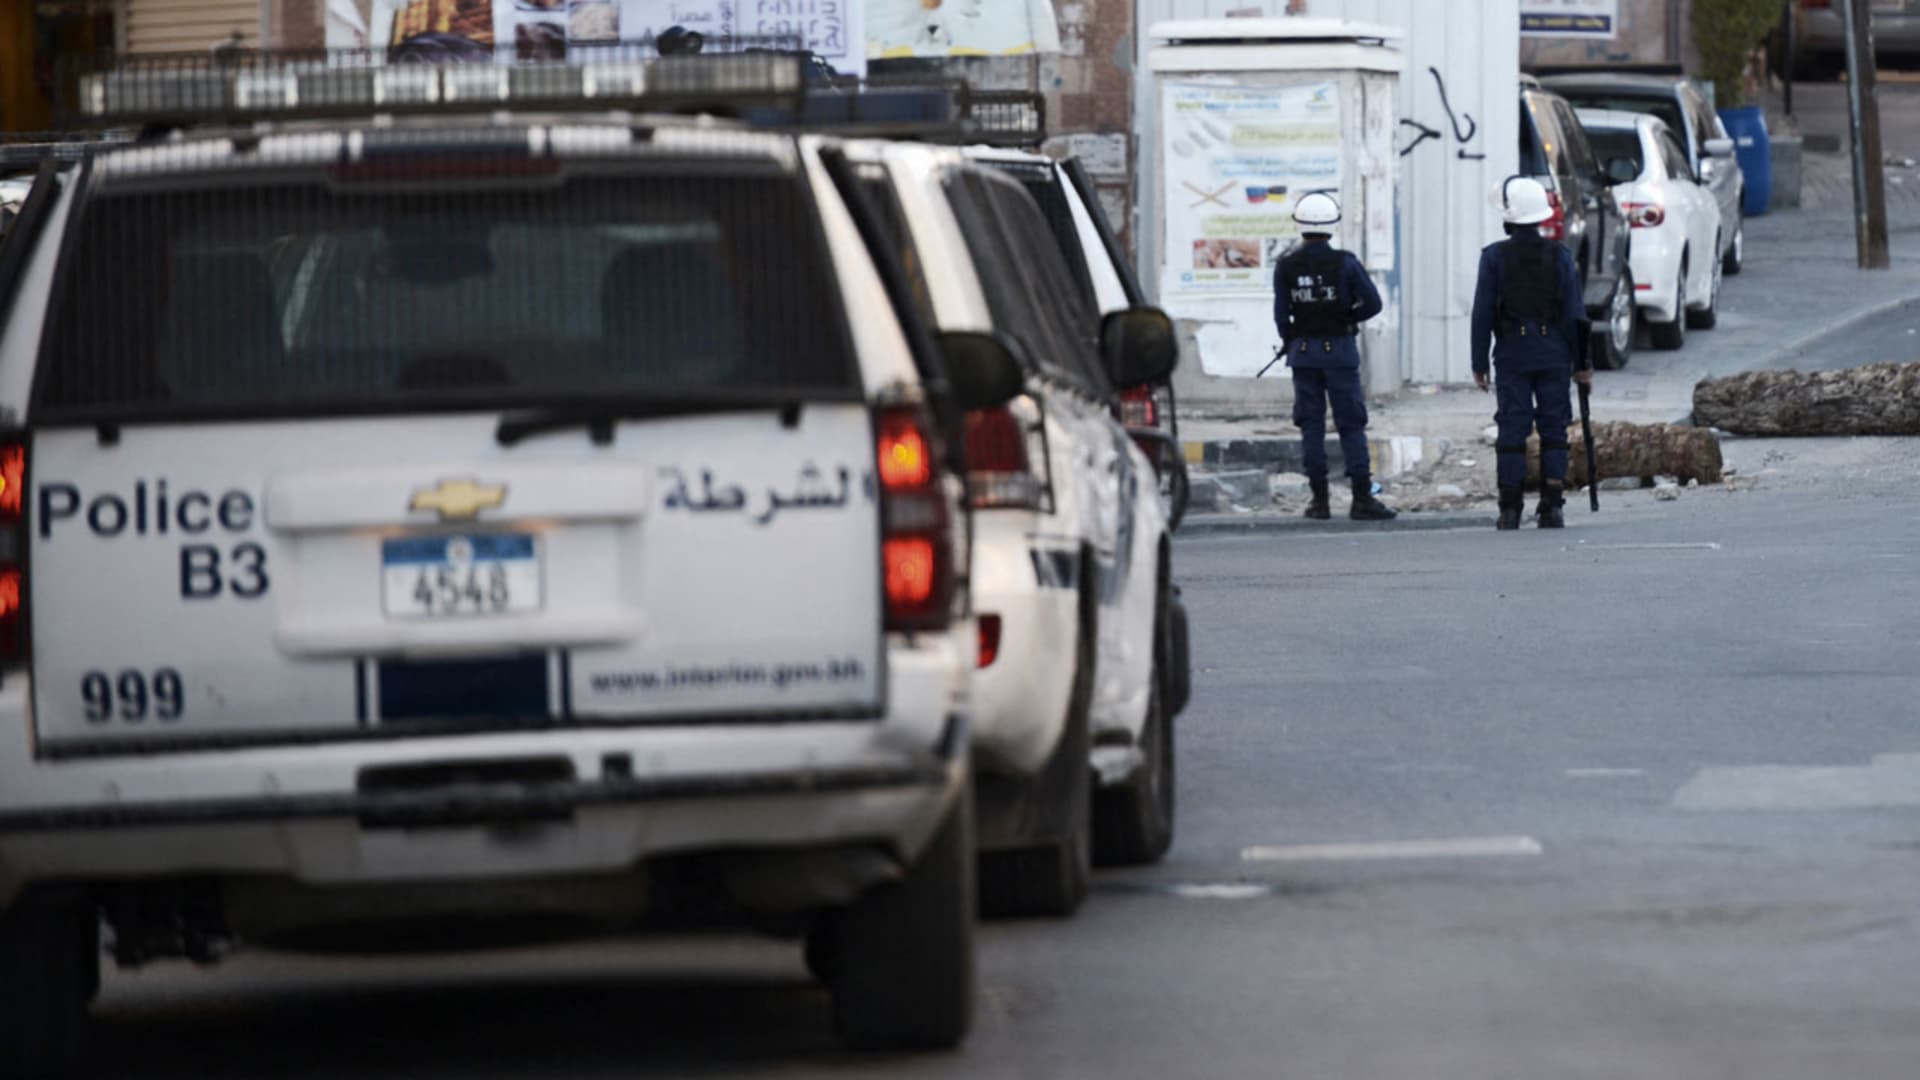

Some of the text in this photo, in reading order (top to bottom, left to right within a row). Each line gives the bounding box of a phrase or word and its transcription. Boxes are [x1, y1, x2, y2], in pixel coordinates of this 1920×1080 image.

[1291, 286, 1336, 302] POLCE
[36, 480, 254, 538] Police
[179, 542, 269, 600] B3
[80, 669, 183, 722] 999
